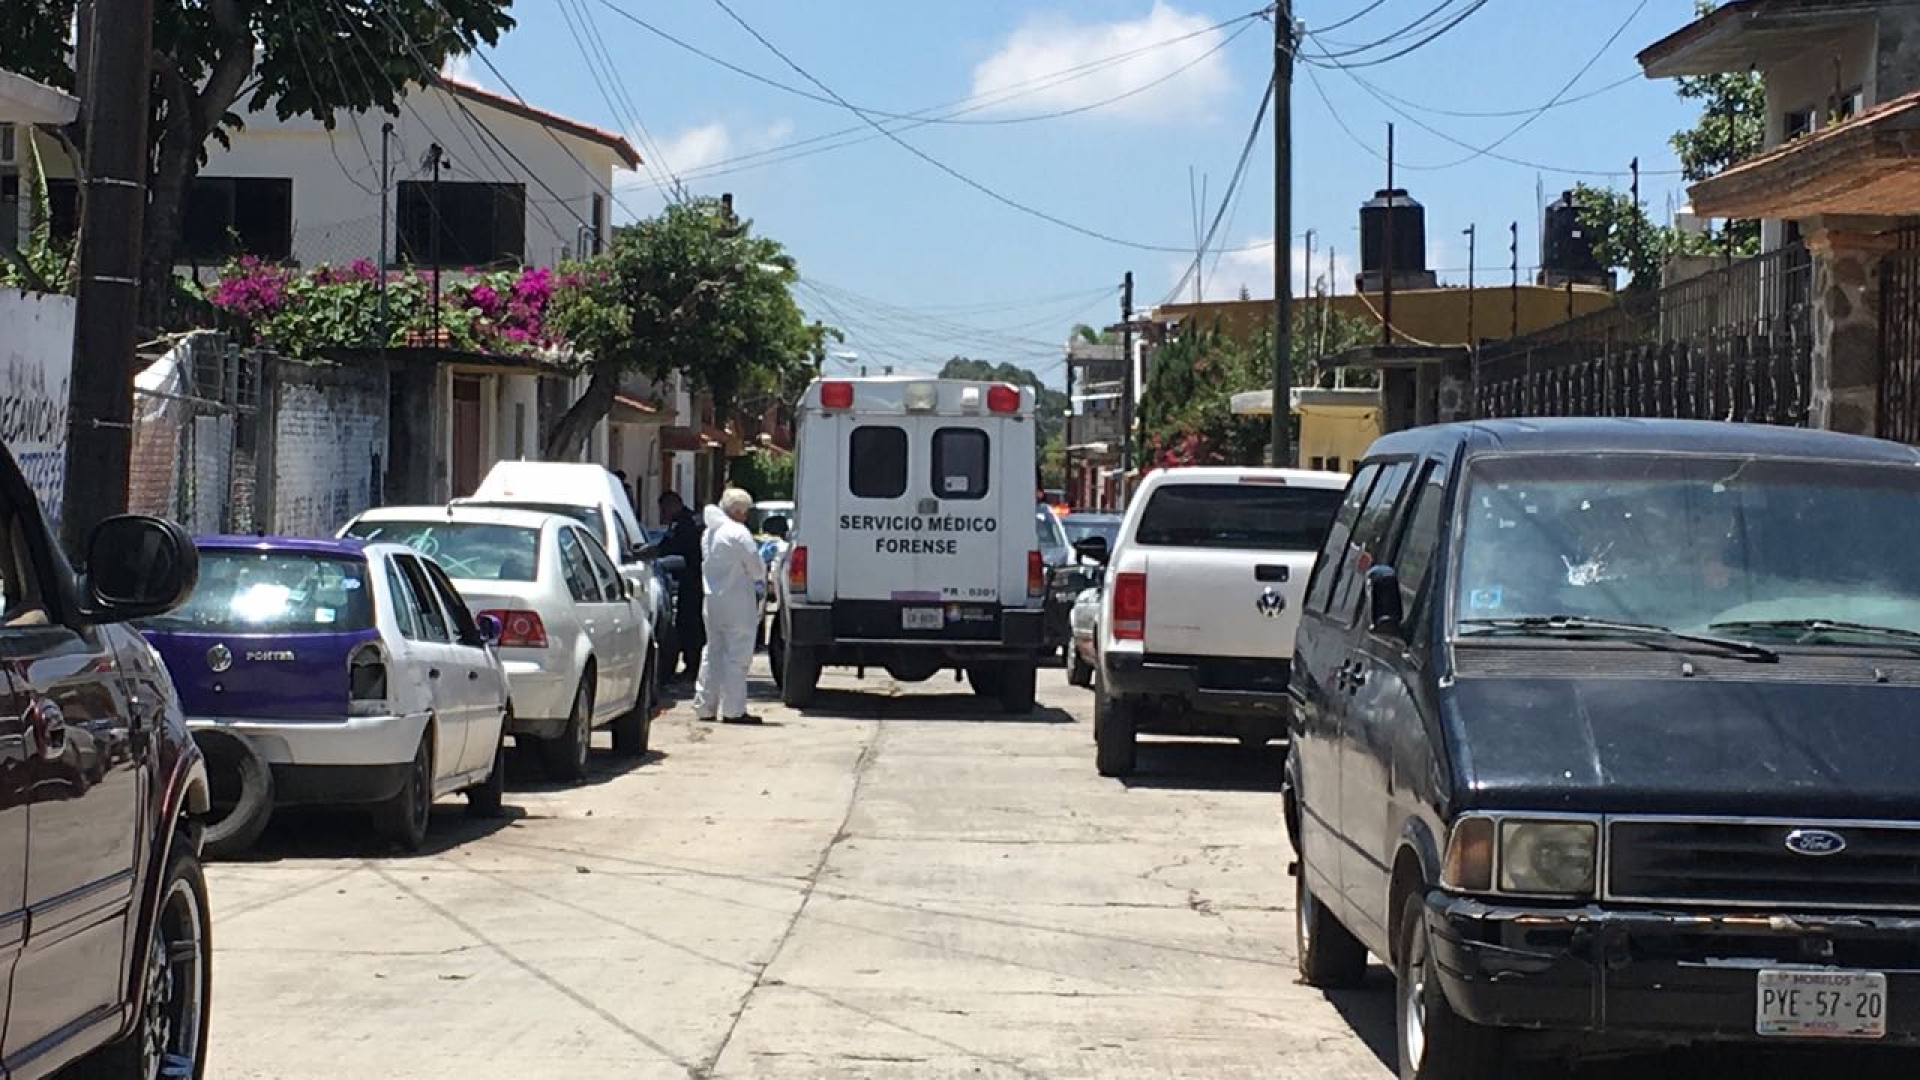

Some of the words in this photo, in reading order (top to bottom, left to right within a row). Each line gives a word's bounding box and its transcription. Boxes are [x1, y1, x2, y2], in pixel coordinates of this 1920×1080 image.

[840, 515, 923, 531] SERVICIO
[928, 512, 997, 532] MÉDICO
[875, 538, 957, 554] FORENSE
[1793, 974, 1851, 986] MORELOS
[1763, 989, 1881, 1018] PYE-57-20
